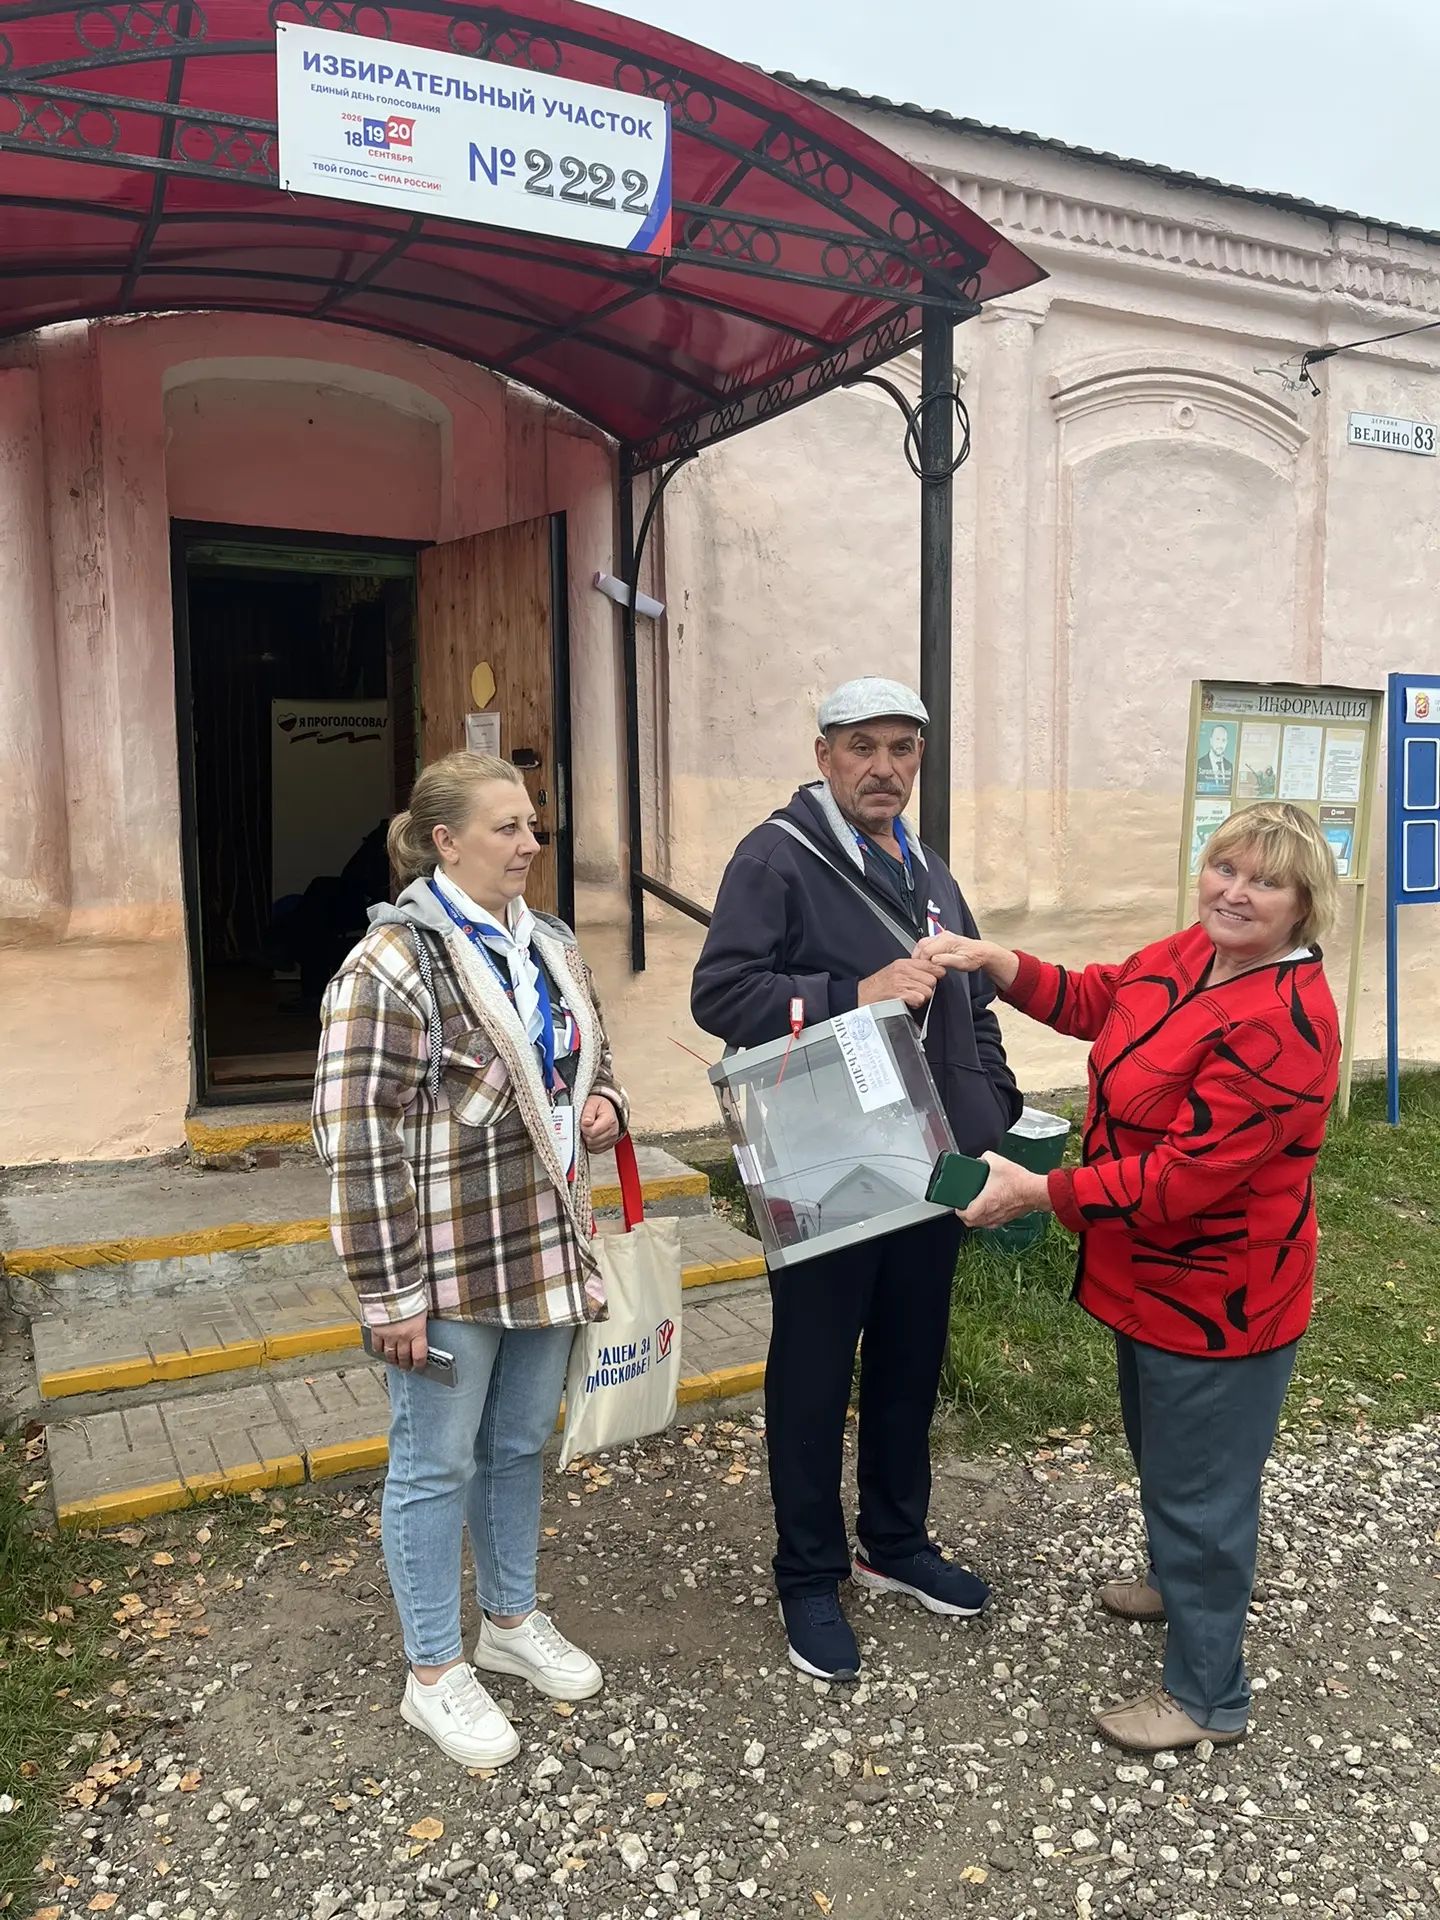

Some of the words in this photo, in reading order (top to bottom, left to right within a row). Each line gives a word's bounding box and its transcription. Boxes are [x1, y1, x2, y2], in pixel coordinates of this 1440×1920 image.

[303, 51, 535, 114] ИЗБИРАТЕЛЬНЫЙ
[542, 98, 653, 140] УЧАСТОК
[311, 83, 350, 98] ЕДИНЫЙ
[351, 91, 375, 102] ДЕНЬ
[376, 95, 441, 114] ГОЛОСОВАНИЯ
[344, 130, 363, 147] 18
[366, 125, 385, 143] 19
[388, 121, 411, 140] 20
[368, 148, 414, 164] СЕНТЯБРЯ
[312, 162, 337, 173] ТВОЙ
[339, 166, 369, 179] ГОЛОС
[378, 173, 402, 184] СИЛА
[404, 178, 442, 191] РОССИИ!
[469, 142, 516, 186] №
[524, 149, 650, 216] 2222
[1354, 426, 1410, 446] ВЕЛИНО
[1414, 426, 1434, 450] 83
[1258, 695, 1367, 718] ИНФОРМАЦИЯ
[299, 717, 305, 728] Я
